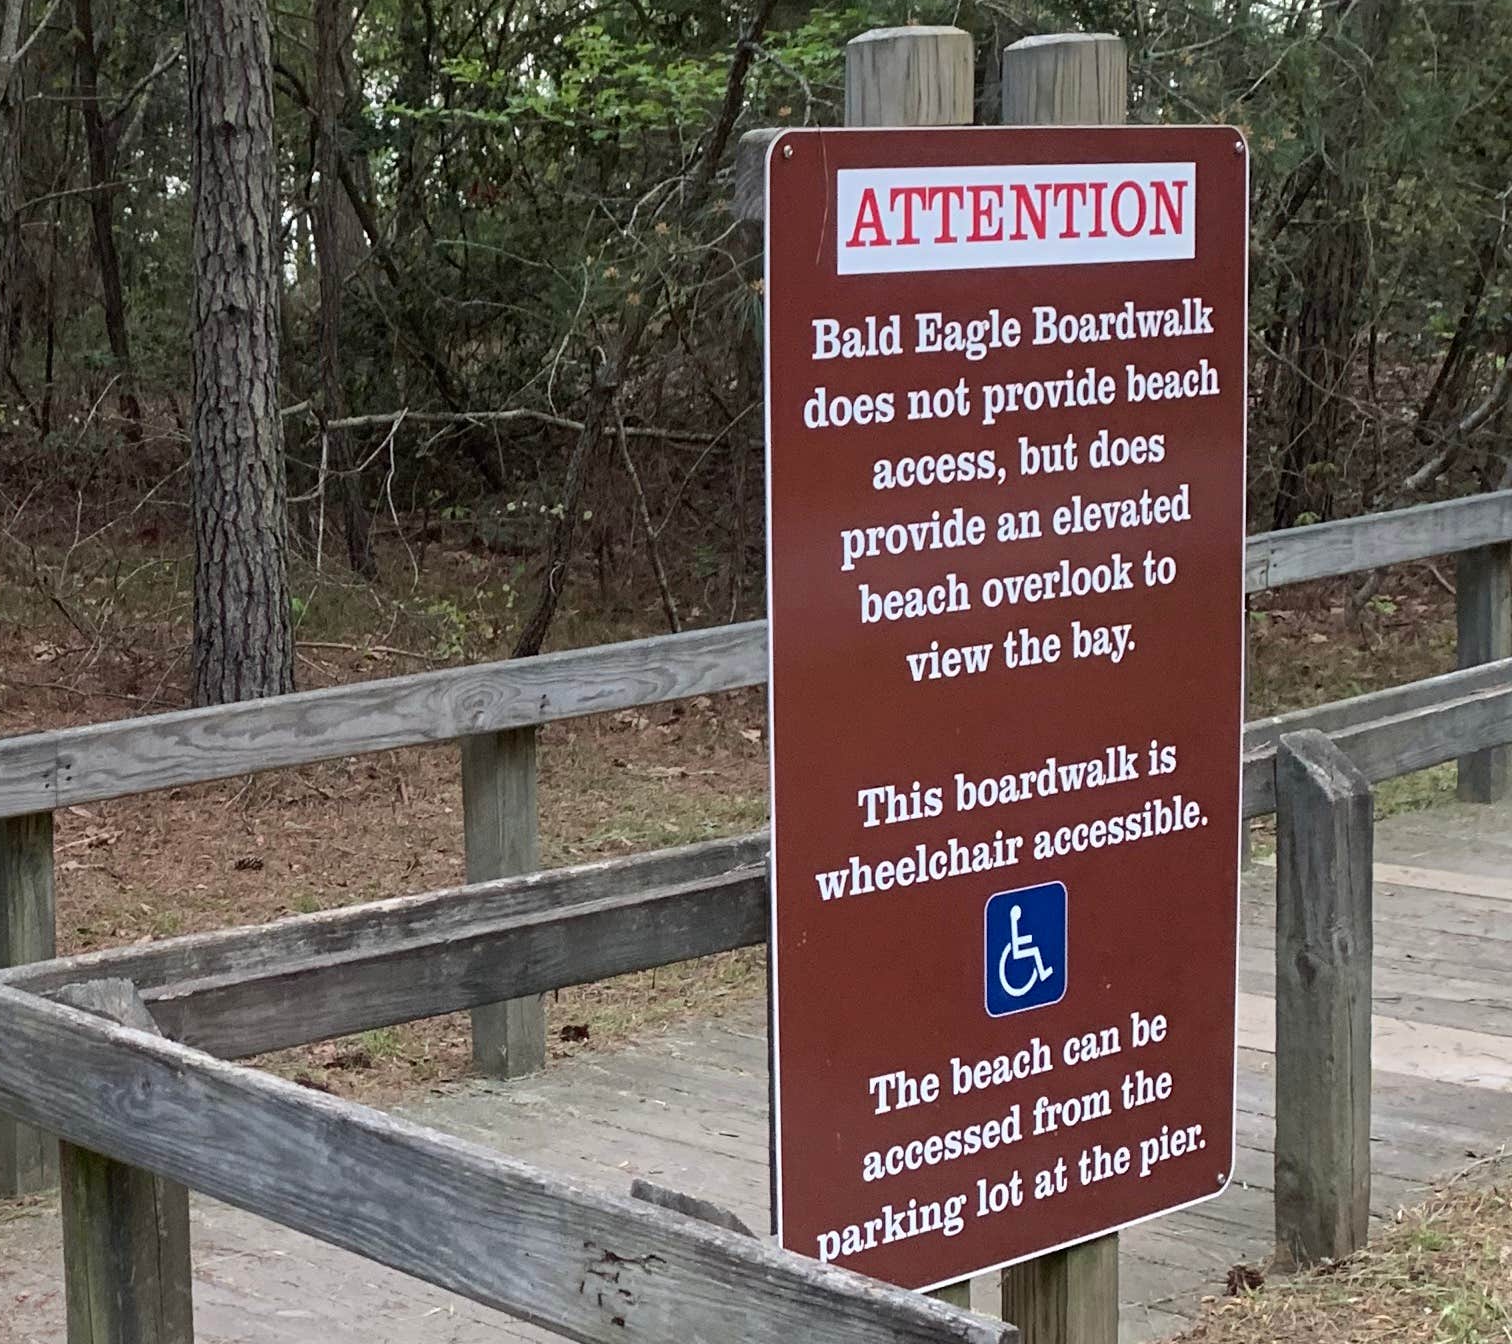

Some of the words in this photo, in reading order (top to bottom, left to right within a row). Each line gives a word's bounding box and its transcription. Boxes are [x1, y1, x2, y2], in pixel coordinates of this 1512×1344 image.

[846, 180, 1188, 248] ATTENTION
[811, 314, 904, 360] Bald
[914, 308, 1022, 361] Eagle
[1031, 297, 1214, 345] Boardwalk
[803, 386, 895, 429] does
[907, 377, 971, 420] not
[982, 367, 1116, 426] provide
[1125, 358, 1221, 402] beach
[872, 449, 1007, 490] access,
[1017, 433, 1078, 476] but
[1089, 429, 1166, 469] does
[840, 507, 986, 572] provide
[996, 509, 1043, 543] an
[1052, 483, 1192, 536] elevated
[858, 573, 972, 624] beach
[981, 553, 1134, 608] overlook
[1142, 550, 1177, 587] to
[905, 640, 994, 682] view
[1003, 628, 1061, 669] the
[1070, 620, 1136, 664] bay.
[857, 780, 944, 828] This
[953, 744, 1140, 812] boardwalk
[1147, 739, 1177, 776] is
[814, 829, 1024, 901] wheelchair
[1033, 794, 1208, 860] accessible.
[869, 1070, 940, 1115] The
[949, 1037, 1054, 1096] beach
[1063, 1026, 1122, 1063] can
[1130, 1011, 1168, 1048] be
[862, 1103, 1023, 1182] accessed
[1032, 1089, 1113, 1136] from
[1120, 1069, 1173, 1110] the
[816, 1194, 967, 1263] parking
[976, 1169, 1024, 1217] lot
[1033, 1157, 1068, 1200] at
[1077, 1144, 1131, 1186] the
[1139, 1124, 1206, 1178] pier.
